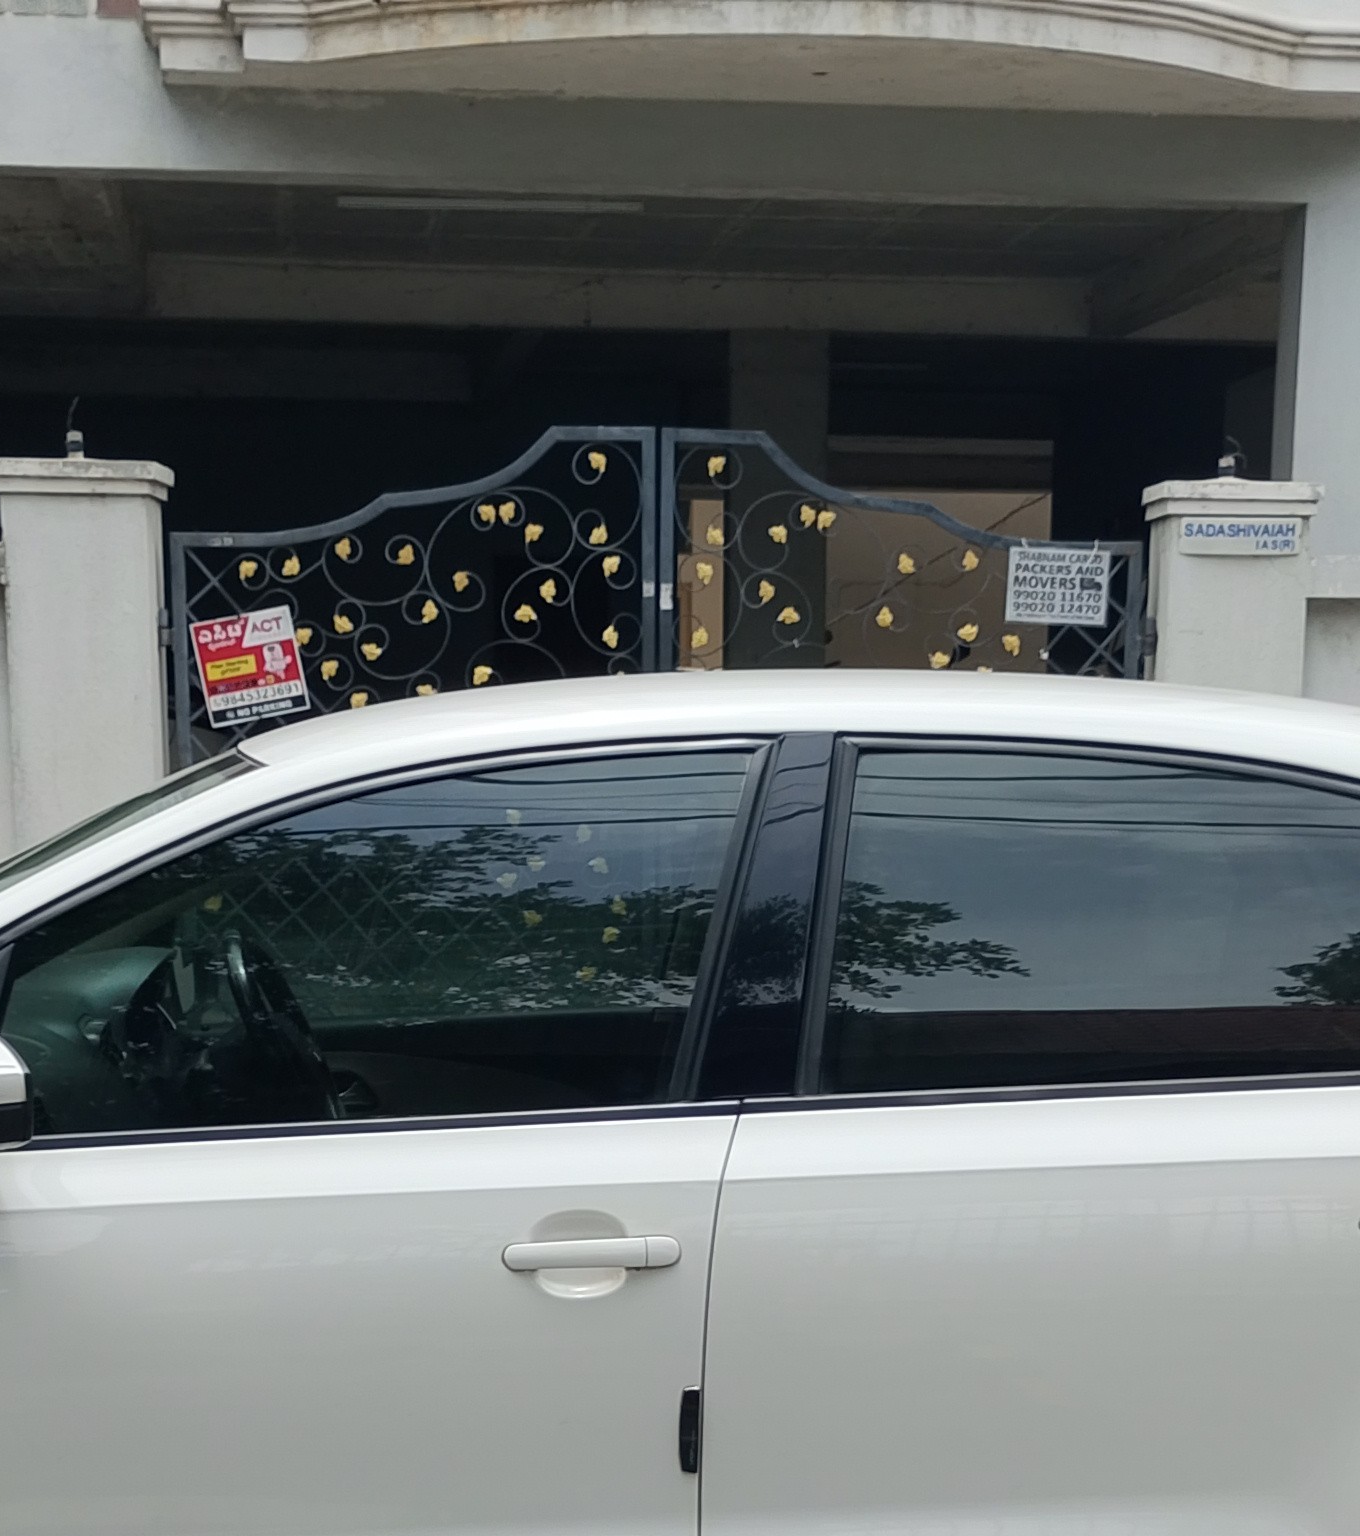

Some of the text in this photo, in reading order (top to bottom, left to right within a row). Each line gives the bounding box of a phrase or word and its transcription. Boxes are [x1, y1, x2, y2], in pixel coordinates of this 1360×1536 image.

[1184, 523, 1296, 538] SADASHIVAIAH
[1015, 563, 1104, 577] PACKERS AND
[1013, 575, 1076, 590] MOVERS
[1013, 590, 1055, 601] 99020
[1013, 601, 1055, 612] 99020
[251, 616, 282, 633] ACT
[236, 707, 251, 717] NO
